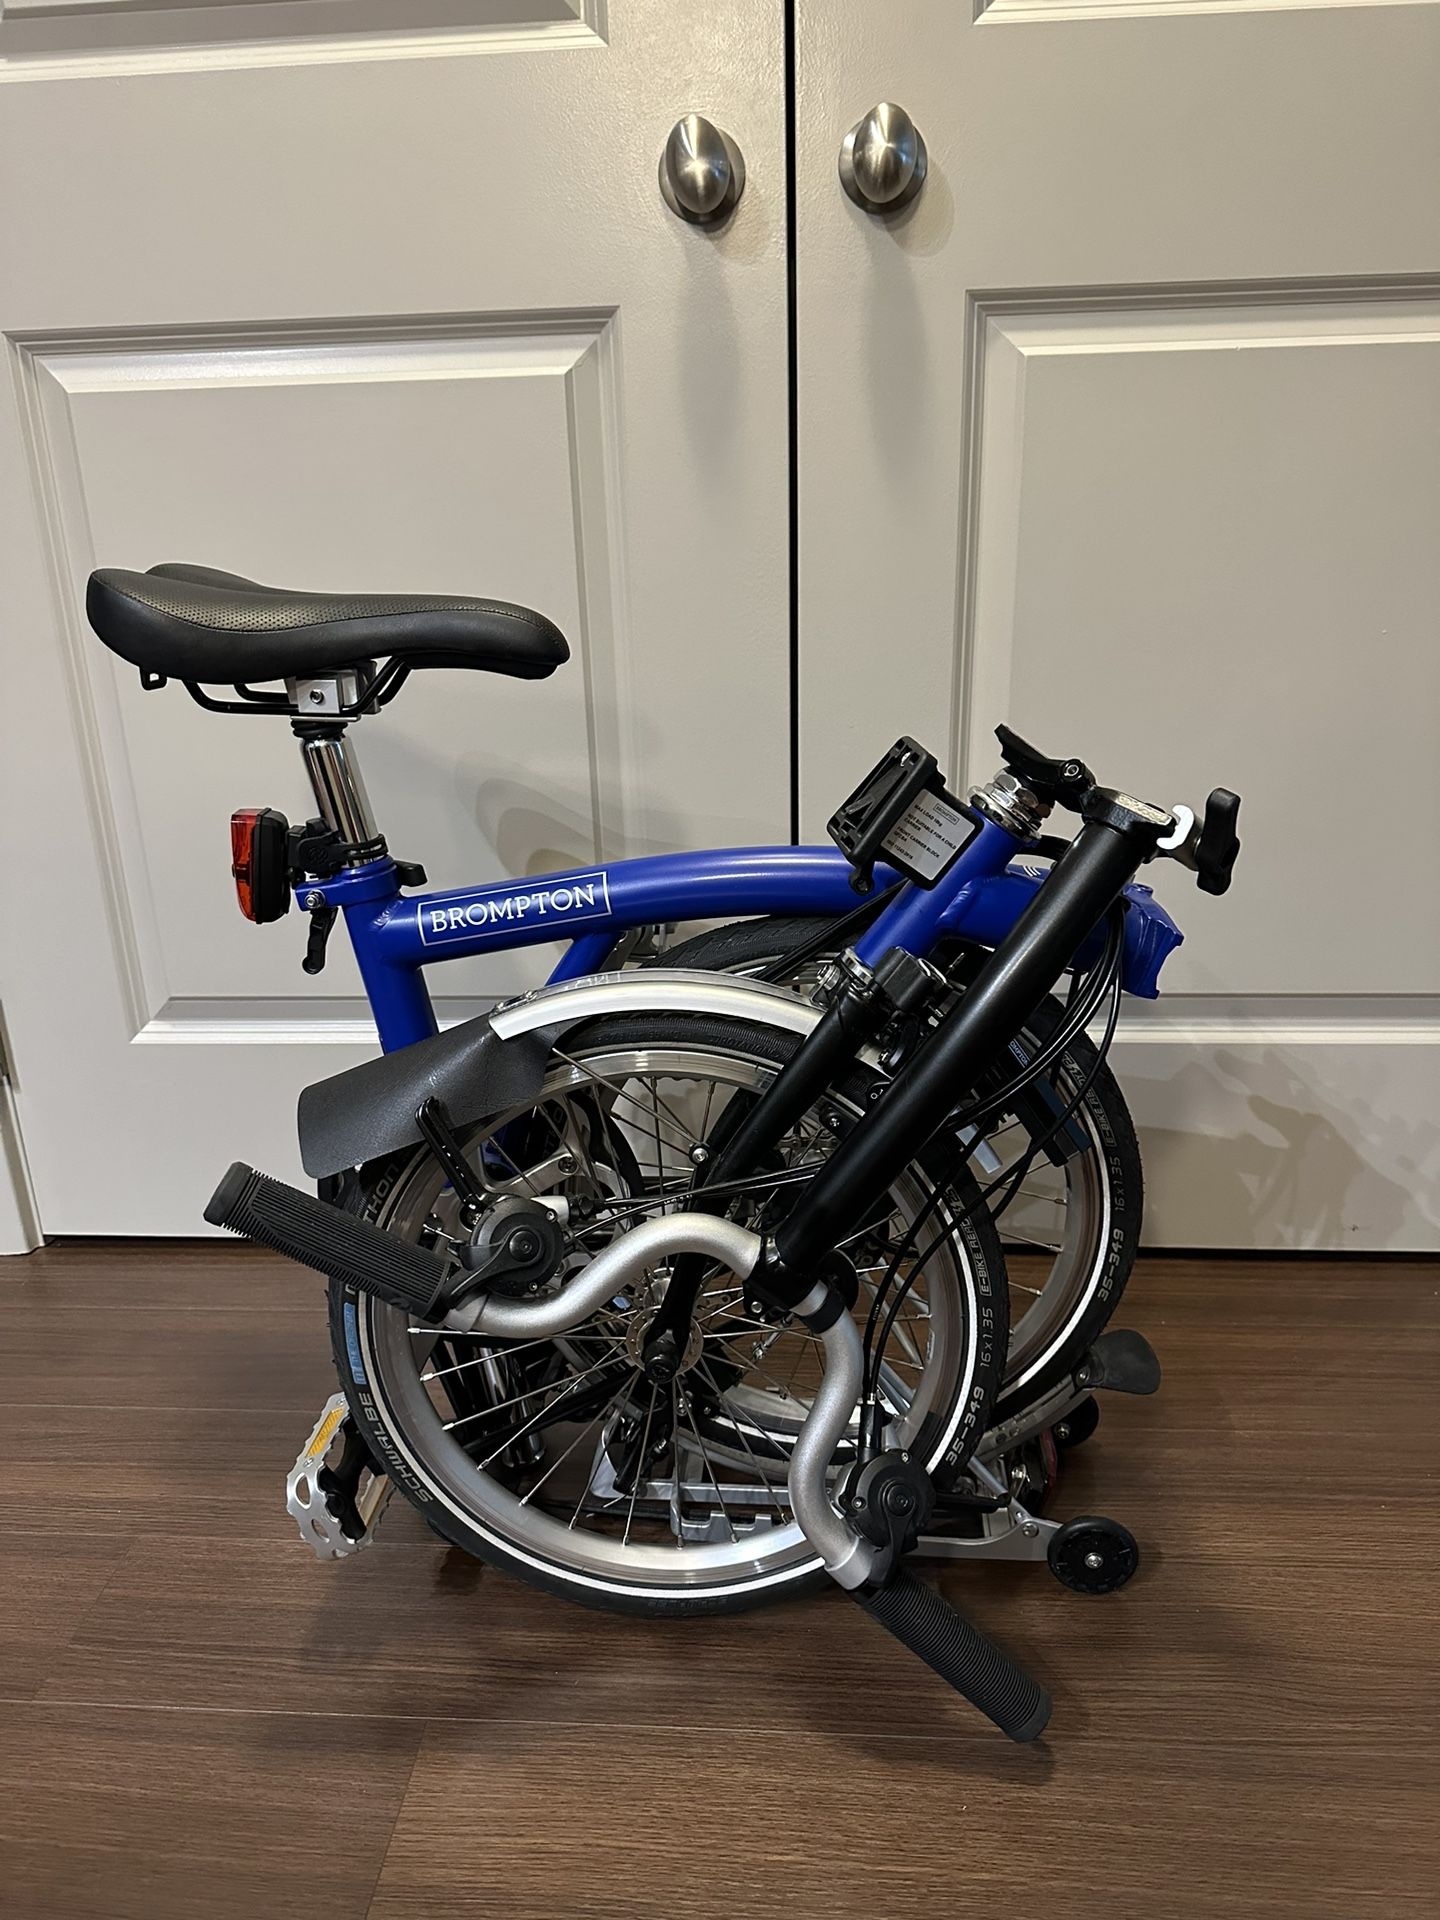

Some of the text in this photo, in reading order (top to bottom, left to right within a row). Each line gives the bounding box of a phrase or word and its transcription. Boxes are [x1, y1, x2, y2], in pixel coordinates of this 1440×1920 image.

[904, 817, 922, 831] CARRIER
[907, 813, 916, 821] NOT
[915, 819, 934, 834] SUITABLE
[933, 831, 942, 840] FOR
[944, 839, 957, 850] CHILD
[922, 810, 934, 820] LOAD
[896, 826, 940, 858] FRONT CARRIER BLOCK
[430, 884, 595, 933] BROMPTON
[975, 1253, 990, 1292] E-BIKE
[1097, 1228, 1124, 1301] 35-349
[980, 1307, 994, 1367] 16x1.35
[359, 1393, 434, 1503] SCHWALBE
[946, 1386, 984, 1466] 35-349
